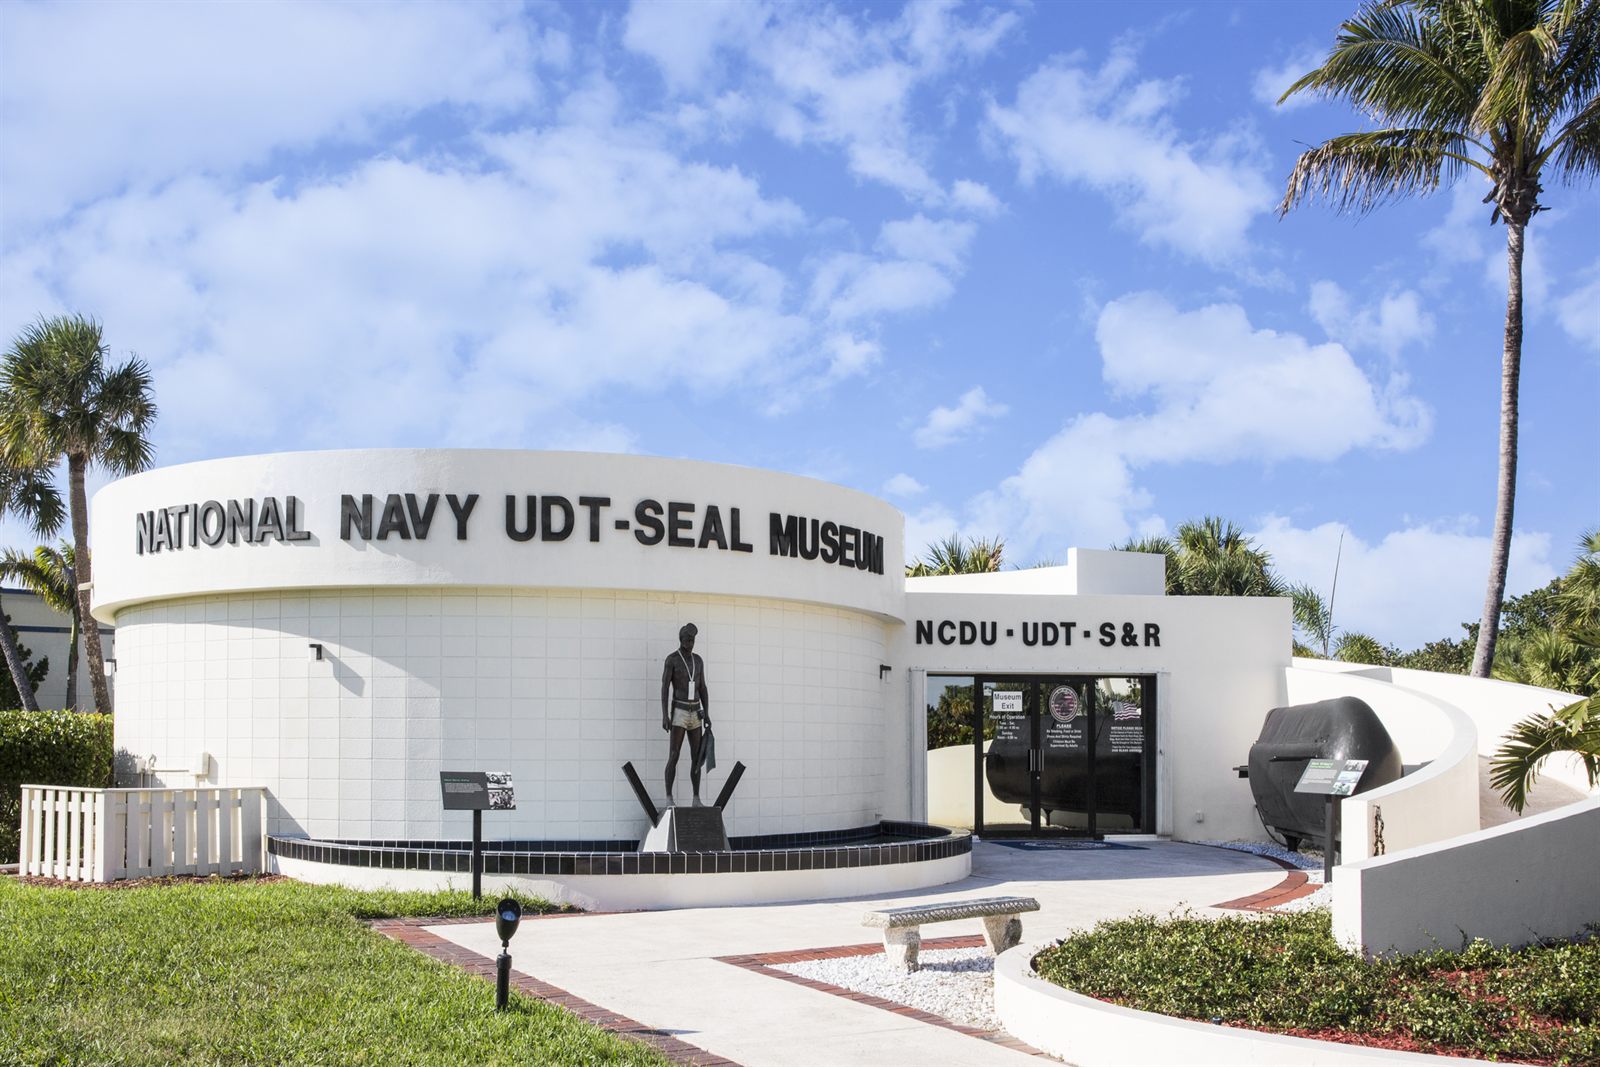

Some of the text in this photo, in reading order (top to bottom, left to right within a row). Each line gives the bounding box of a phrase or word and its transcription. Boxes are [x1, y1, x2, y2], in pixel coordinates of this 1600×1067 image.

[136, 493, 884, 575] NATIONAL NAVY UDT-SEAL MUSEUM
[916, 619, 997, 645] NCDU
[1022, 621, 1077, 646] UDT
[1098, 622, 1161, 647] S&R
